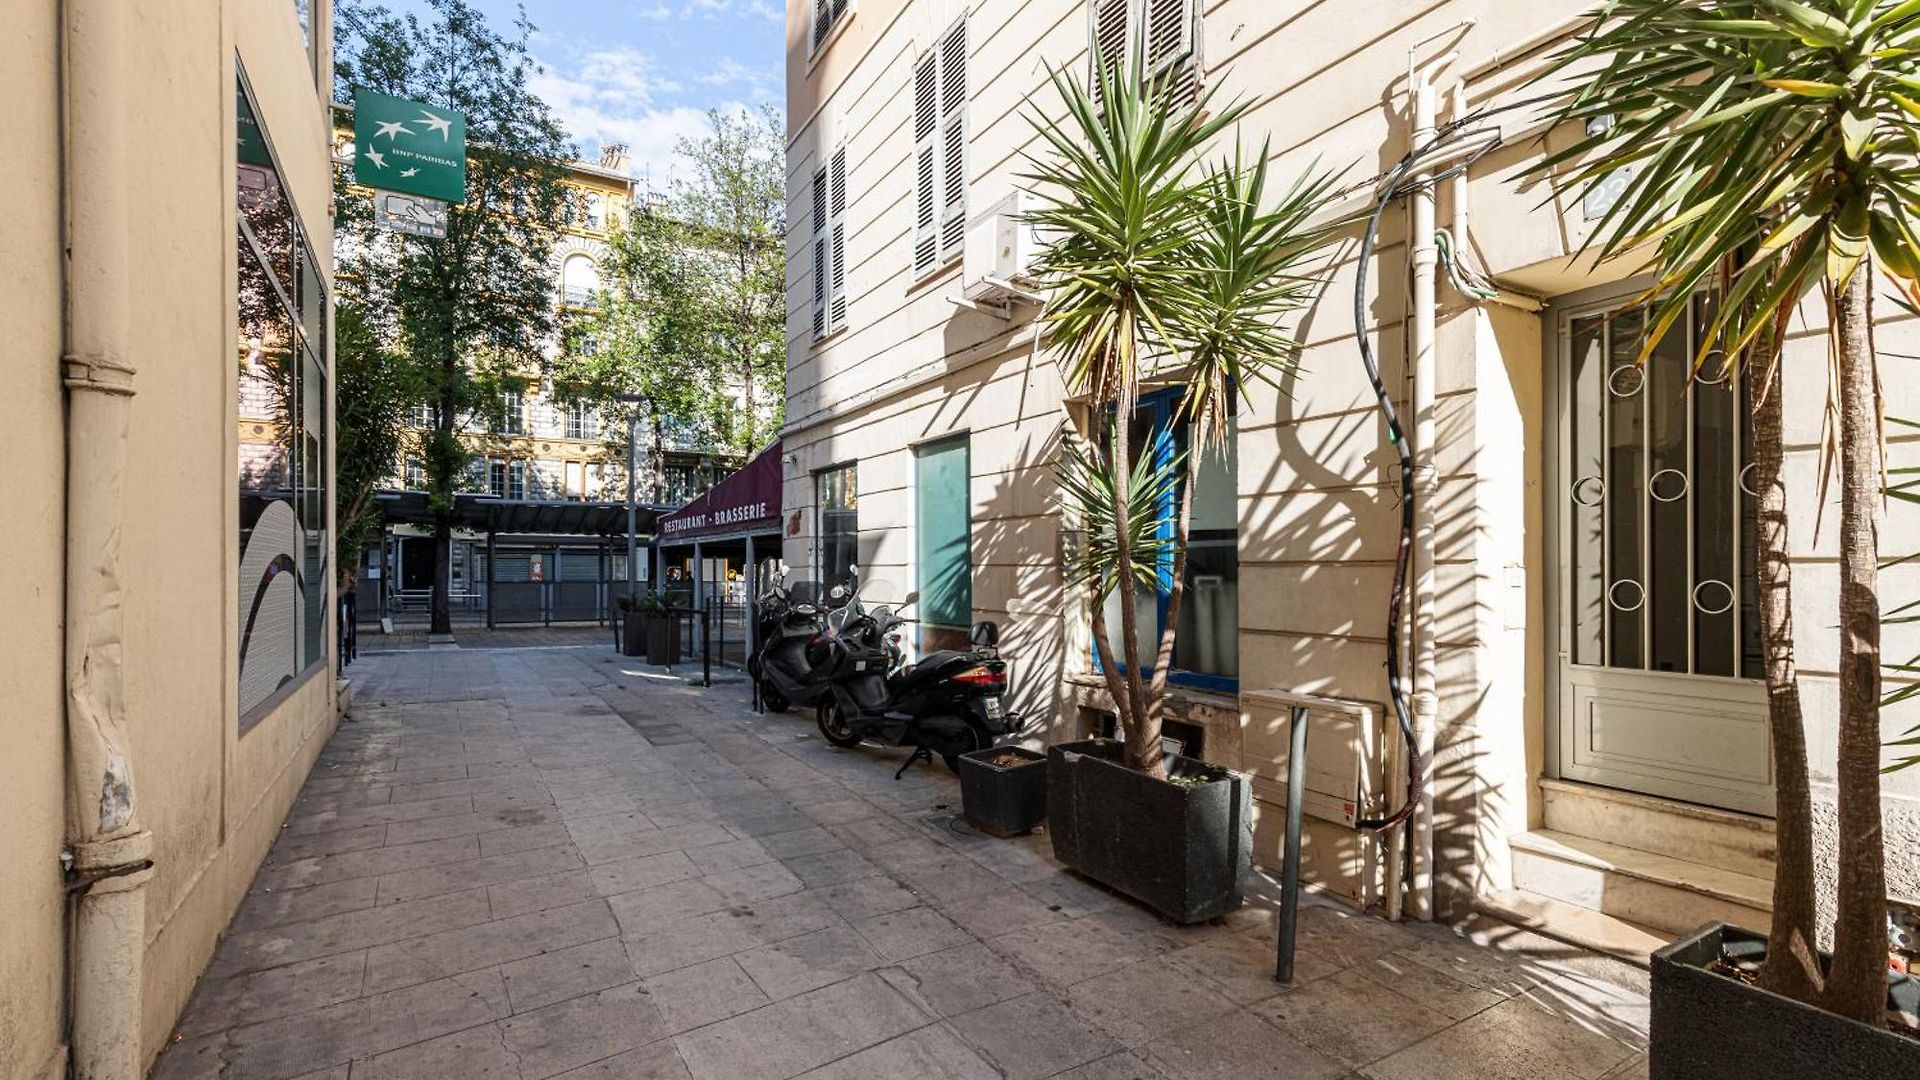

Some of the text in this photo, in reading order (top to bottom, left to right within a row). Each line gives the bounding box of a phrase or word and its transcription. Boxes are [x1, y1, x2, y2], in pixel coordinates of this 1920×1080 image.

[392, 148, 457, 167] BNP PARIBAS
[664, 514, 706, 533] RESTAURANT
[714, 502, 766, 525] BRASSERIE
